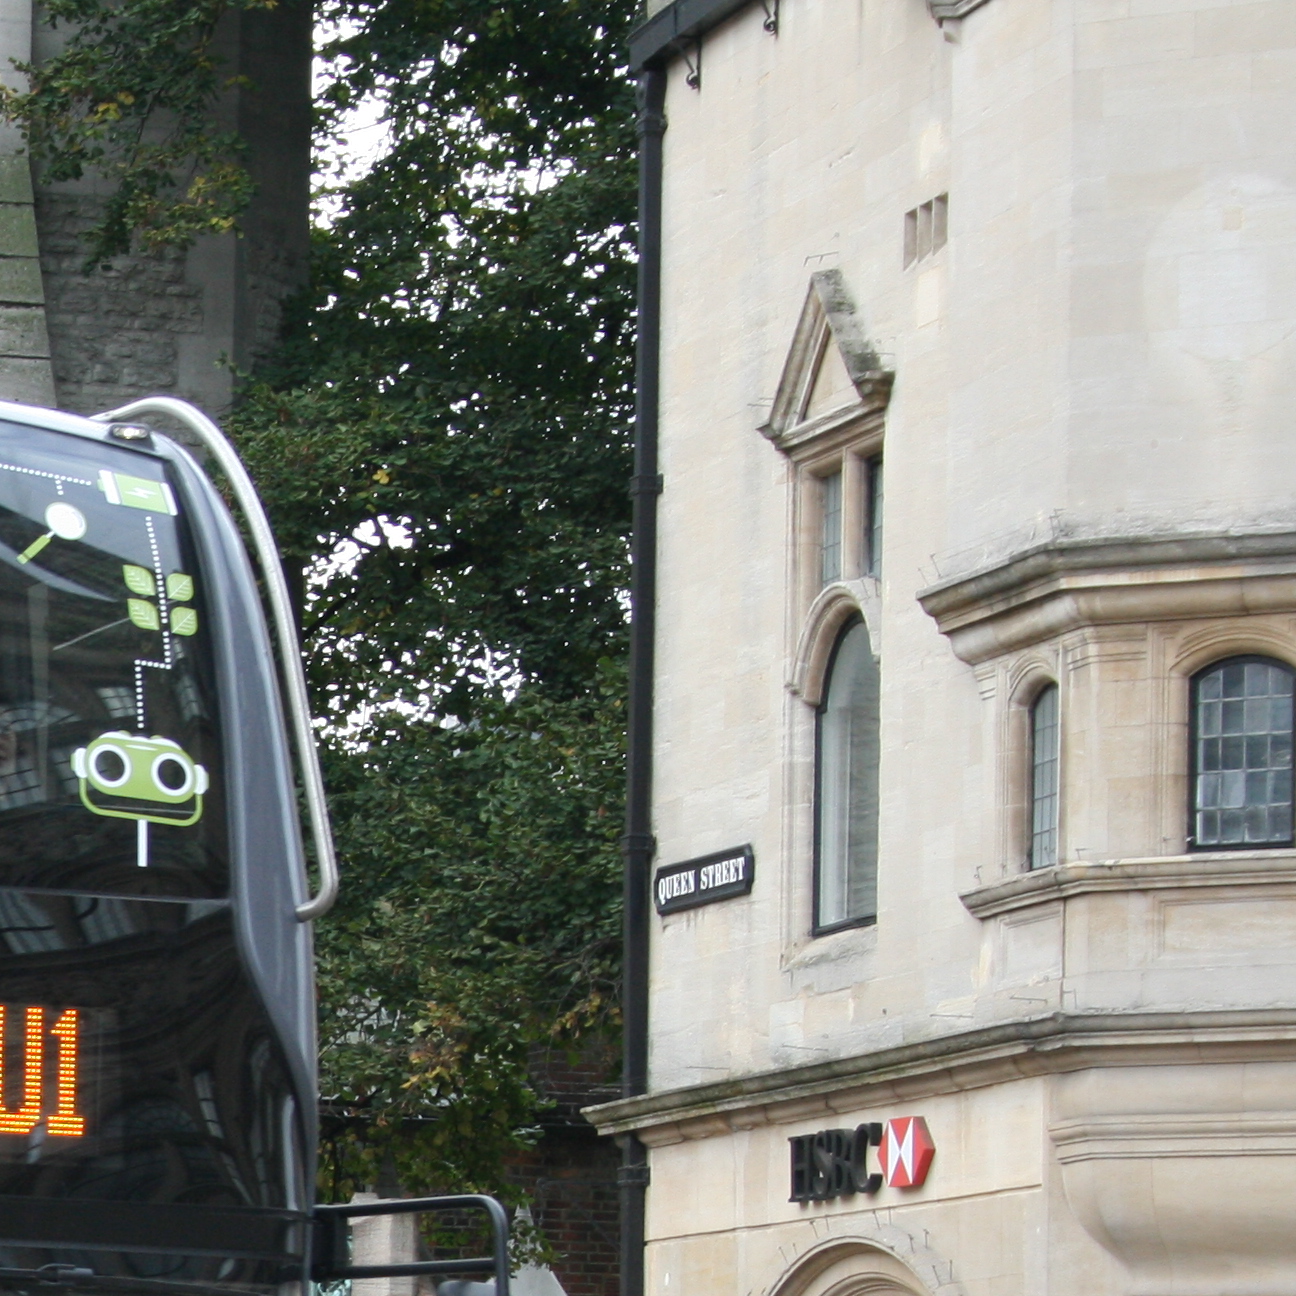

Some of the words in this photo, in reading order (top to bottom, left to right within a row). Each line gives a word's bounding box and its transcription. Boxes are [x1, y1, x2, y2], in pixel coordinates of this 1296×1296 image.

[658, 869, 696, 905] QUEEN
[700, 856, 745, 890] STREET
[788, 1122, 883, 1203] HSBC
